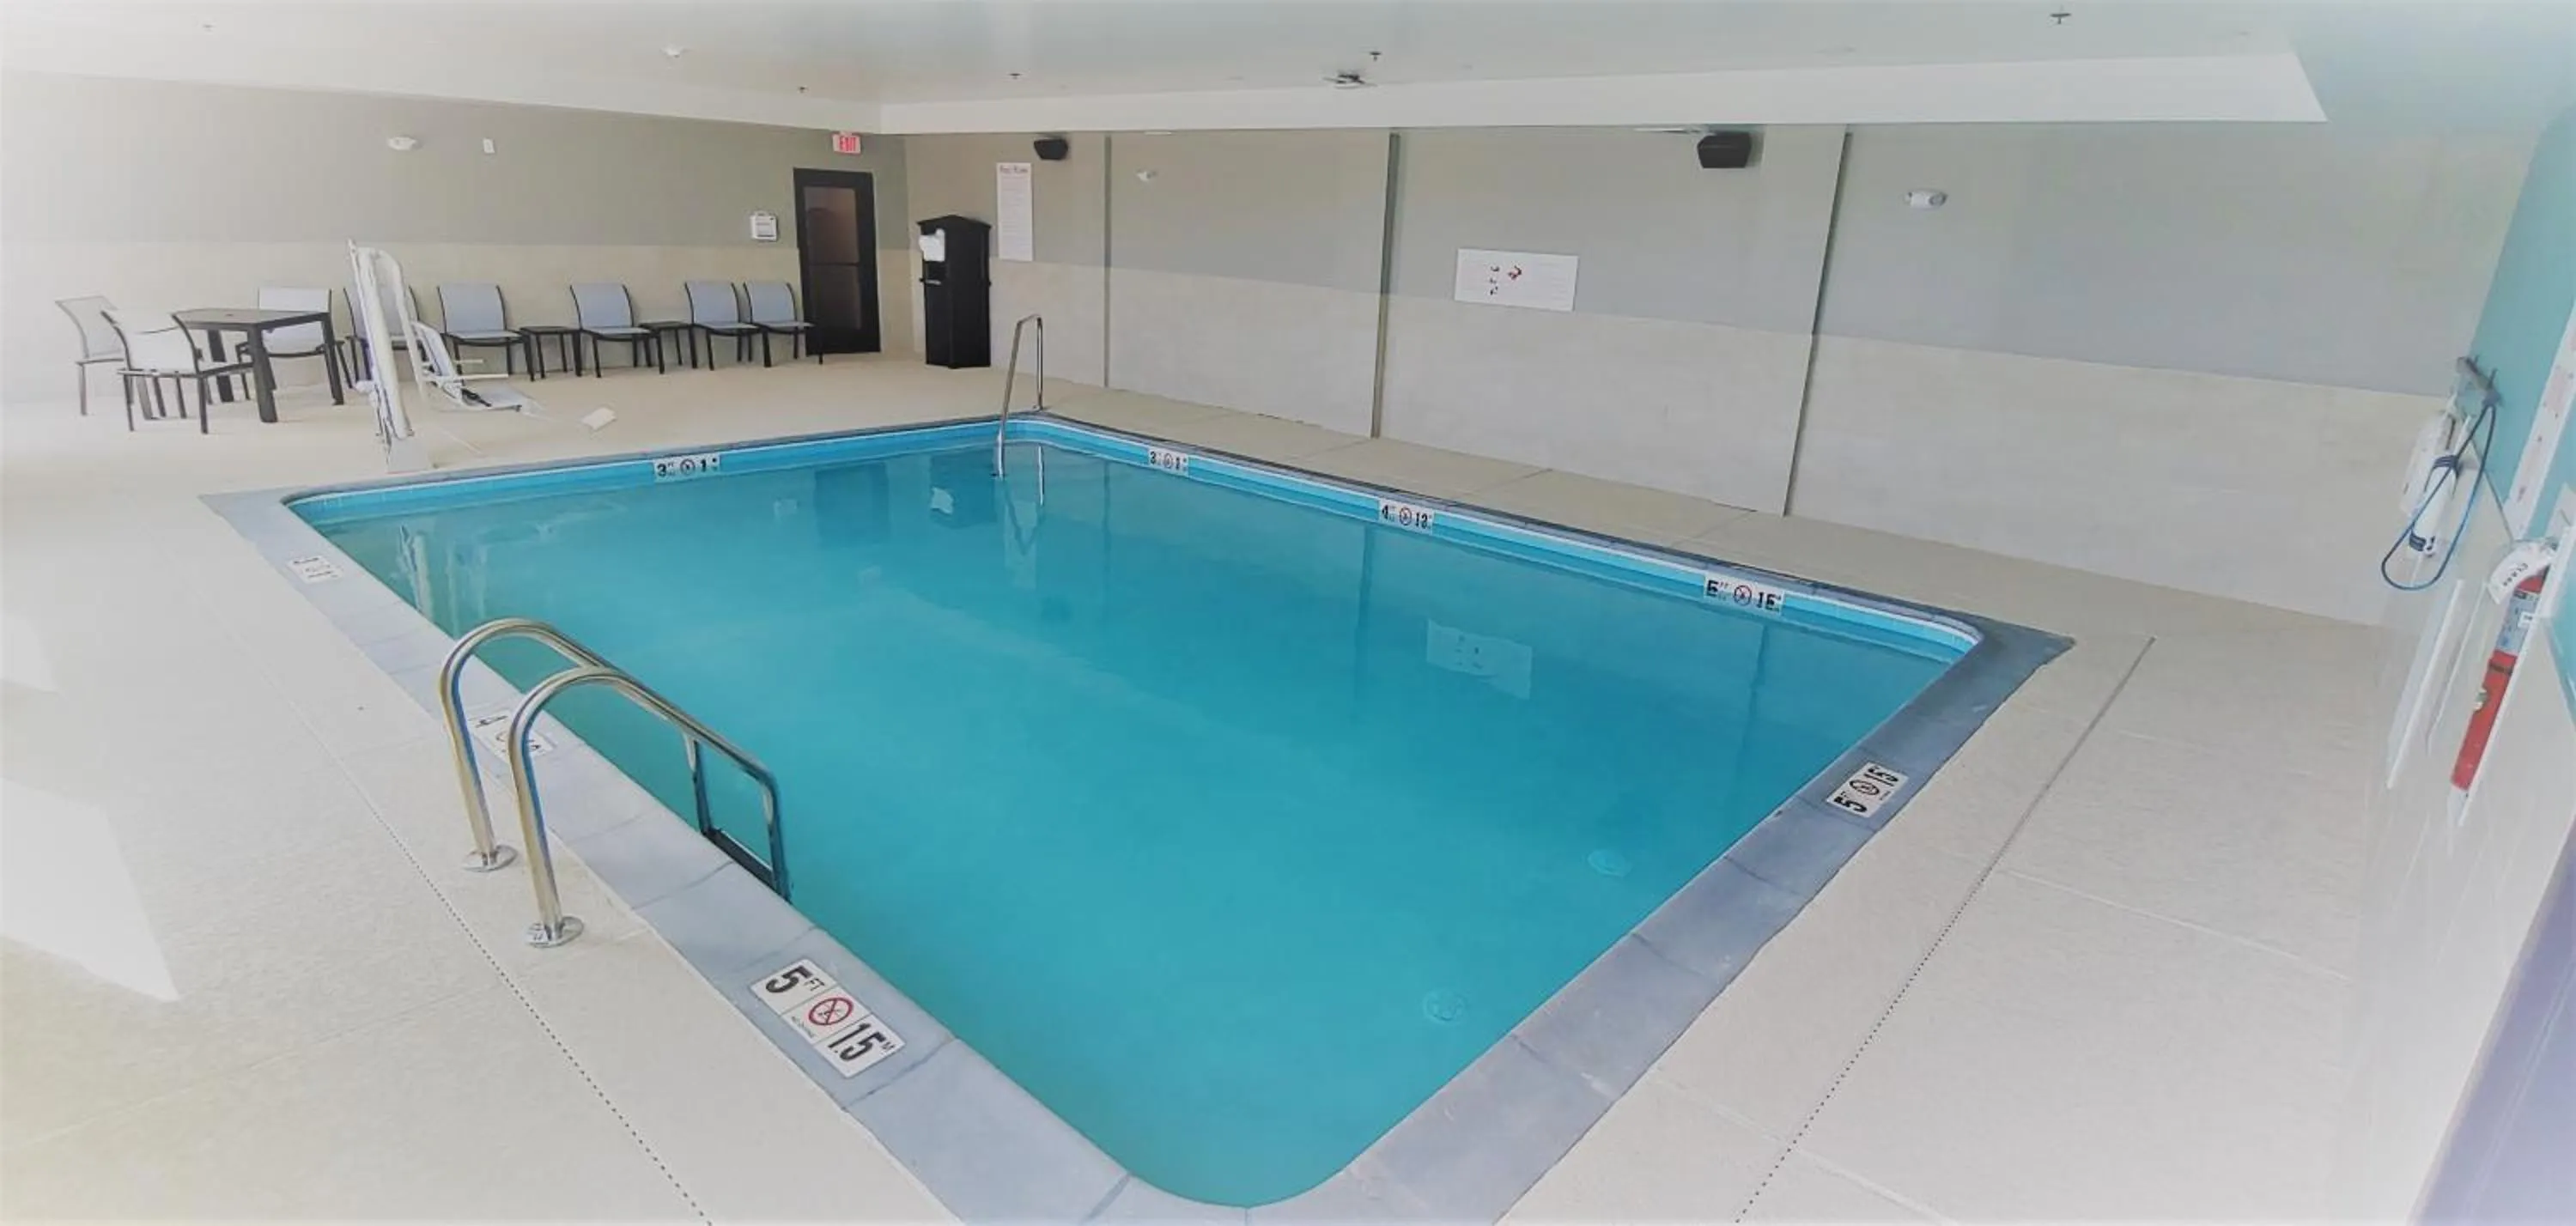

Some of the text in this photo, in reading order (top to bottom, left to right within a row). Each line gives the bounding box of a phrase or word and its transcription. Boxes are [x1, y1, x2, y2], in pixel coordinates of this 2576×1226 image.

[839, 137, 856, 151] EXIT
[656, 464, 667, 476] 3
[1833, 797, 1867, 812] 5
[765, 965, 813, 993] 5
[803, 978, 825, 992] FT
